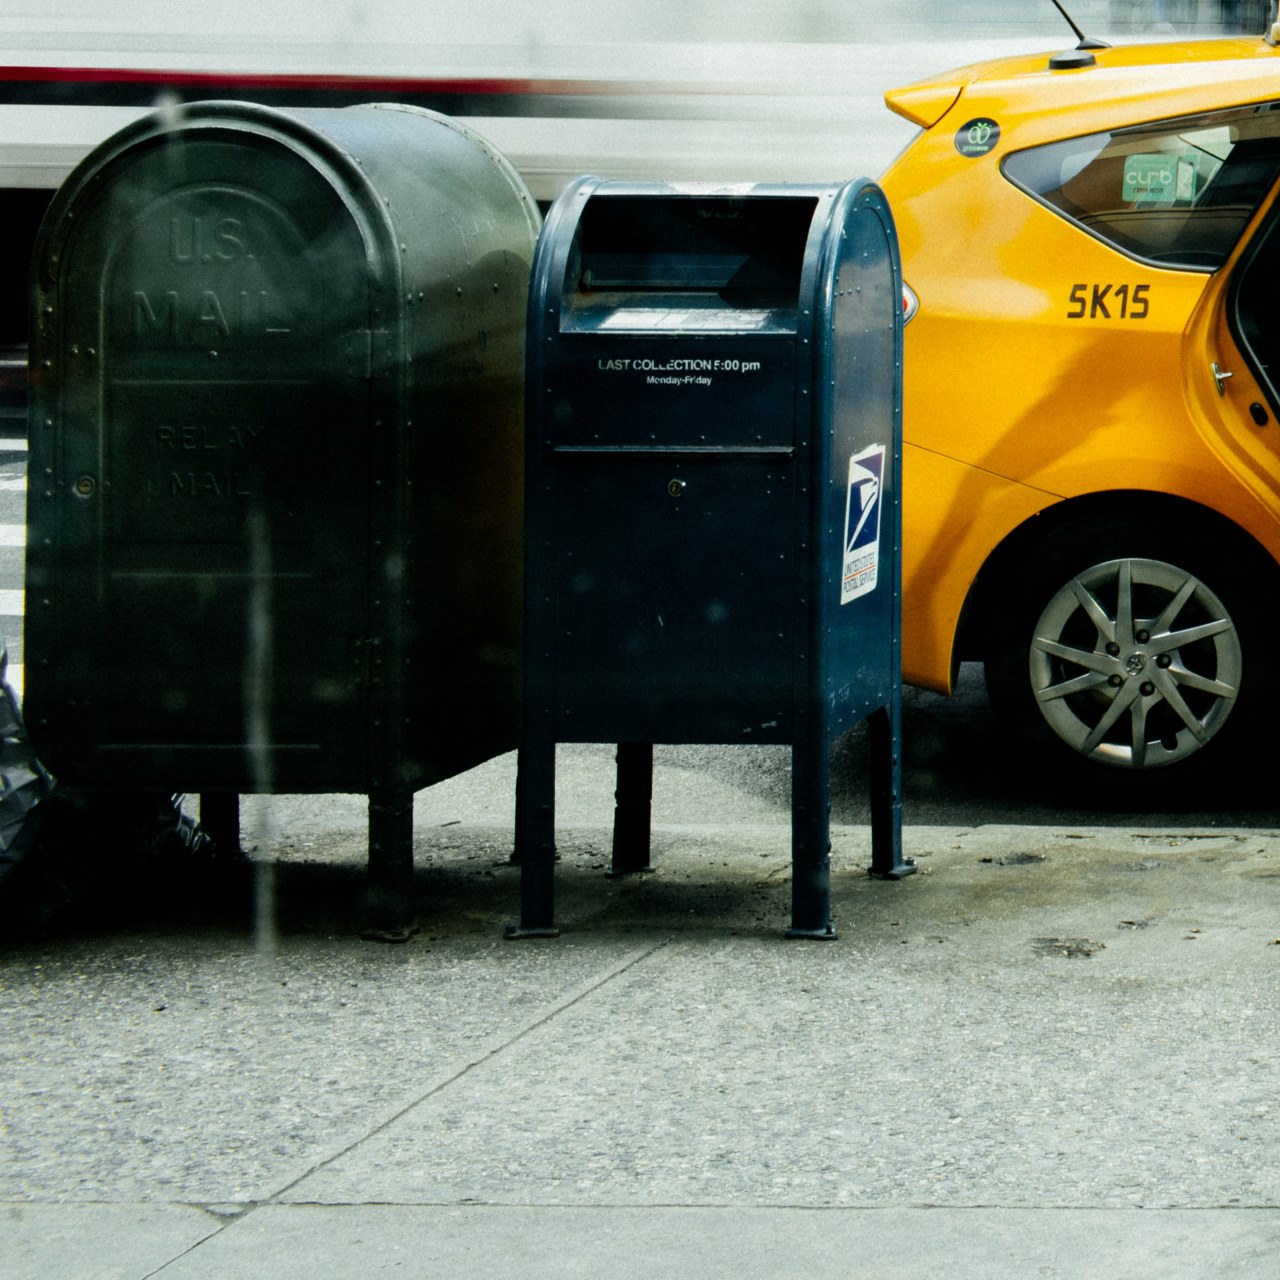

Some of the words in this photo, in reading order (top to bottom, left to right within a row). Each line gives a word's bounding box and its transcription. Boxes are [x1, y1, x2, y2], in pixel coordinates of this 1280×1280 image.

[1126, 170, 1172, 185] curb
[171, 217, 255, 261] U.S.
[133, 290, 292, 337] MAIL
[1067, 284, 1151, 319] 5K15
[598, 359, 631, 370] LAST
[633, 359, 712, 371] COLLECTION
[741, 360, 761, 373] pm
[156, 425, 264, 451] RELAY
[170, 471, 252, 497] MAIL
